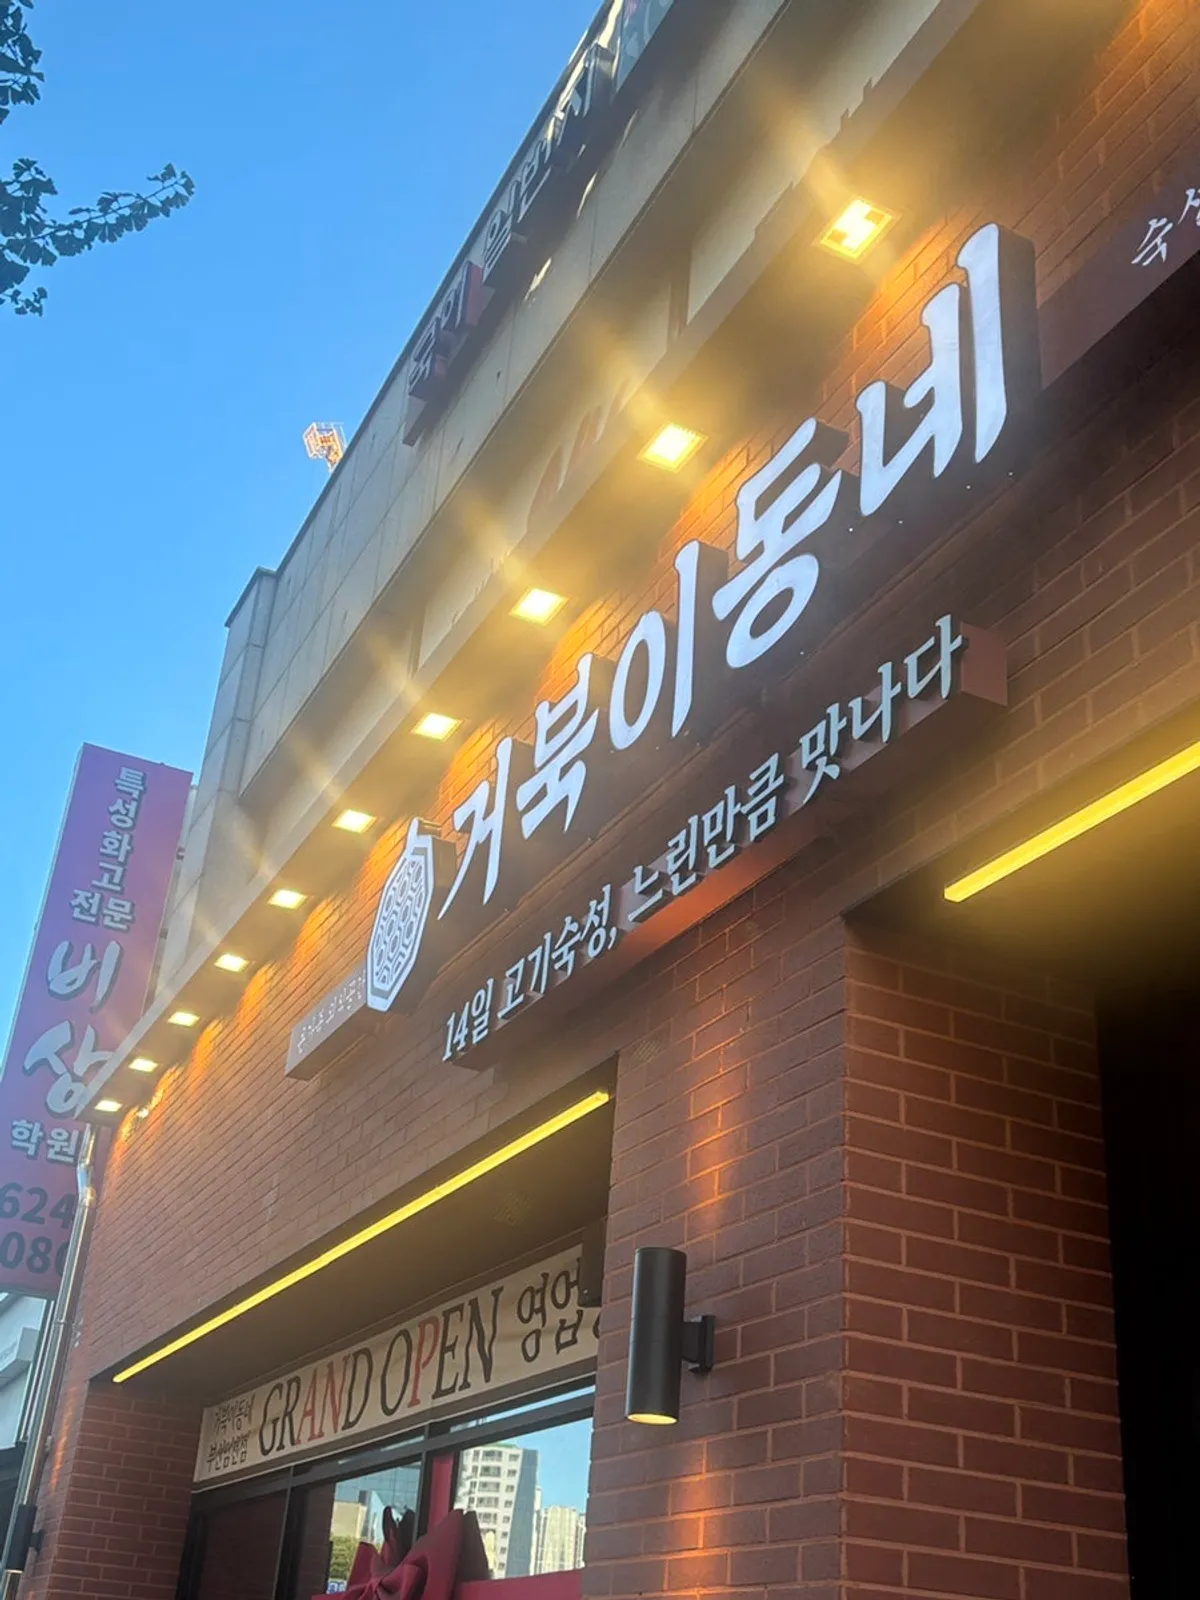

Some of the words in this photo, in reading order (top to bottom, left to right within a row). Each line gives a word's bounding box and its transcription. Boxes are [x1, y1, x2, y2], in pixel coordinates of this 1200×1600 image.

[438, 222, 1007, 920] 거북이동네
[69, 888, 136, 930] 전문
[91, 765, 147, 893] 특성화고
[442, 978, 494, 1063] 14일
[497, 884, 618, 1020] 고기숙성,
[628, 752, 785, 922] 느린만큼
[799, 614, 962, 806] 맛나다
[23, 940, 123, 1119] 비상
[11, 1119, 80, 1163] 학원
[258, 1347, 373, 1458] GRAND
[380, 1286, 504, 1417] OPEN
